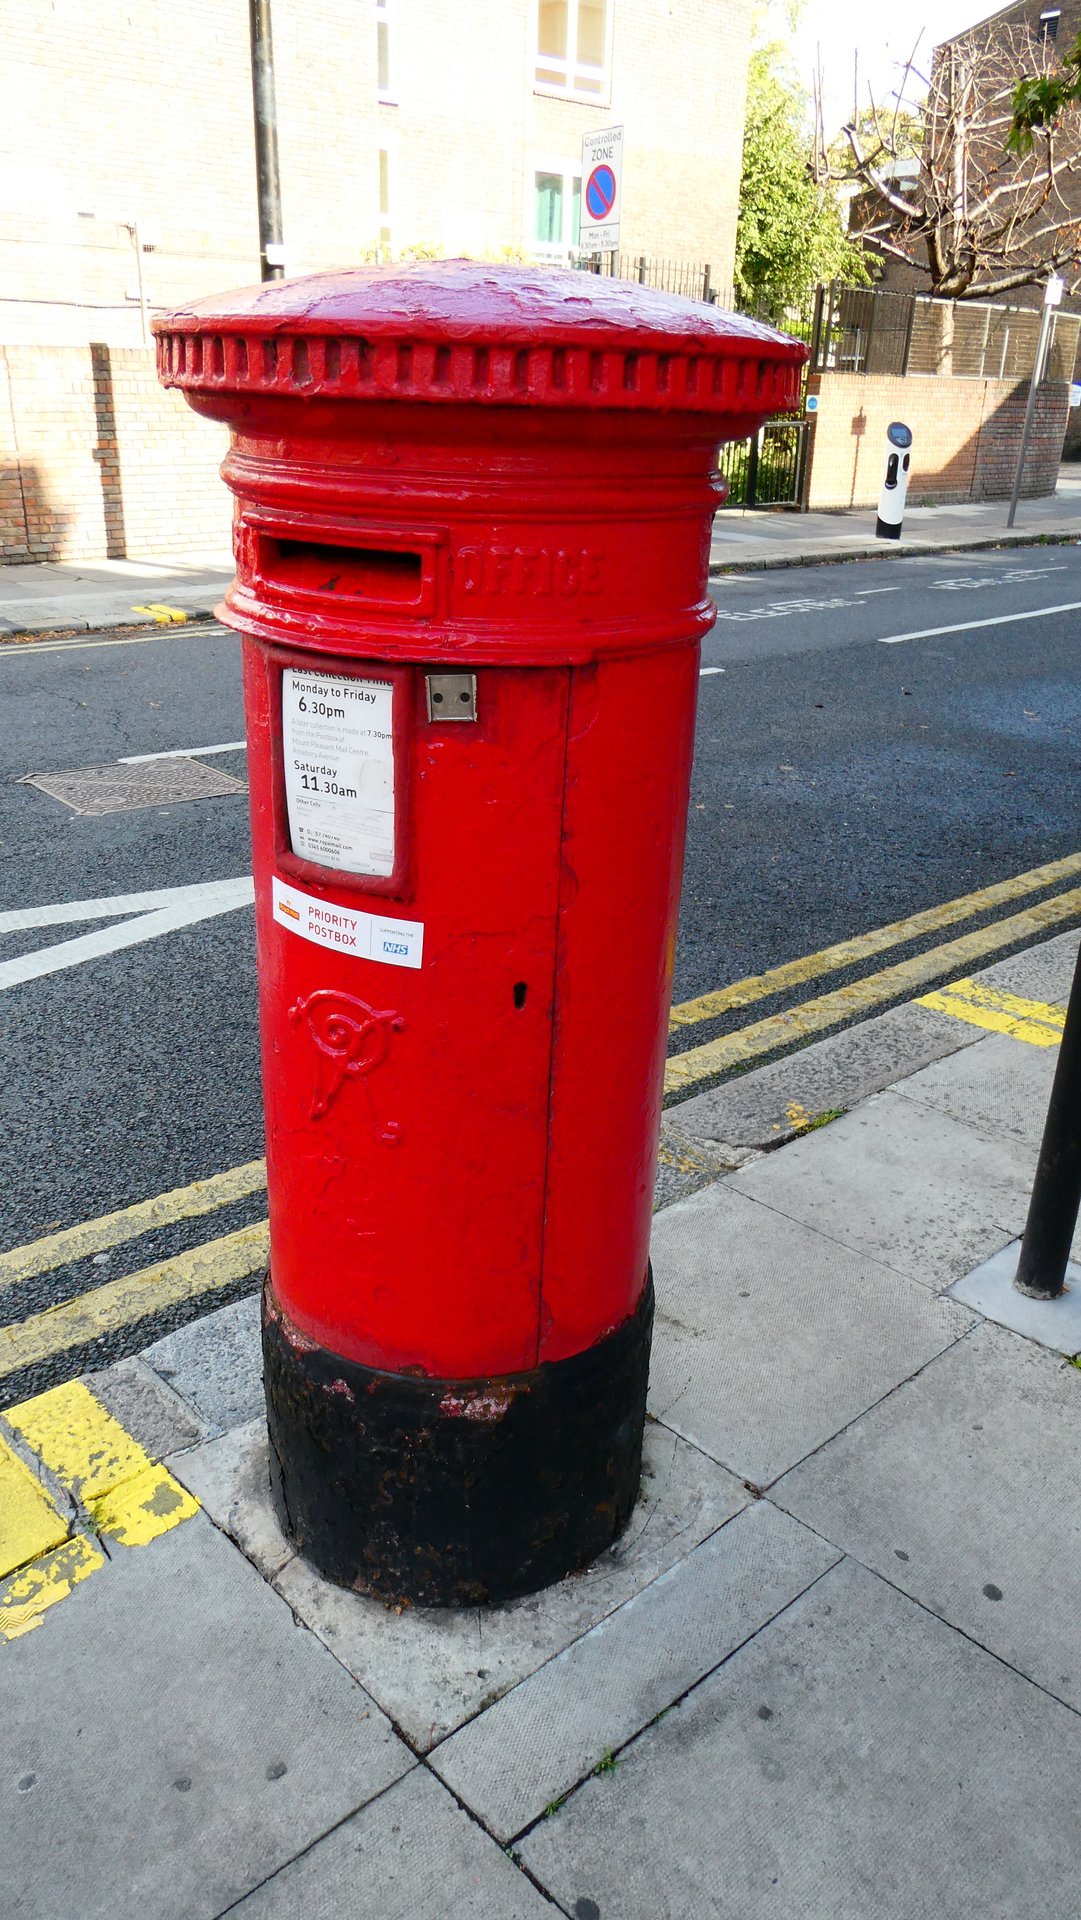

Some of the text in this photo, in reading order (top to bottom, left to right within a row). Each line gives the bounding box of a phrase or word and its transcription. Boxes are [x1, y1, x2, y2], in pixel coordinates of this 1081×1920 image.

[585, 130, 622, 147] Controlled
[592, 147, 614, 161] ZONE
[292, 680, 377, 705] Monday to Friday
[298, 696, 345, 719] 6.30pm
[367, 729, 393, 740] 7.30pm
[293, 759, 338, 778] Saturday
[301, 774, 357, 798] 11.30am
[308, 905, 358, 932] PRIORITY
[308, 921, 358, 948] POSTBOX
[384, 942, 408, 955] NHS
